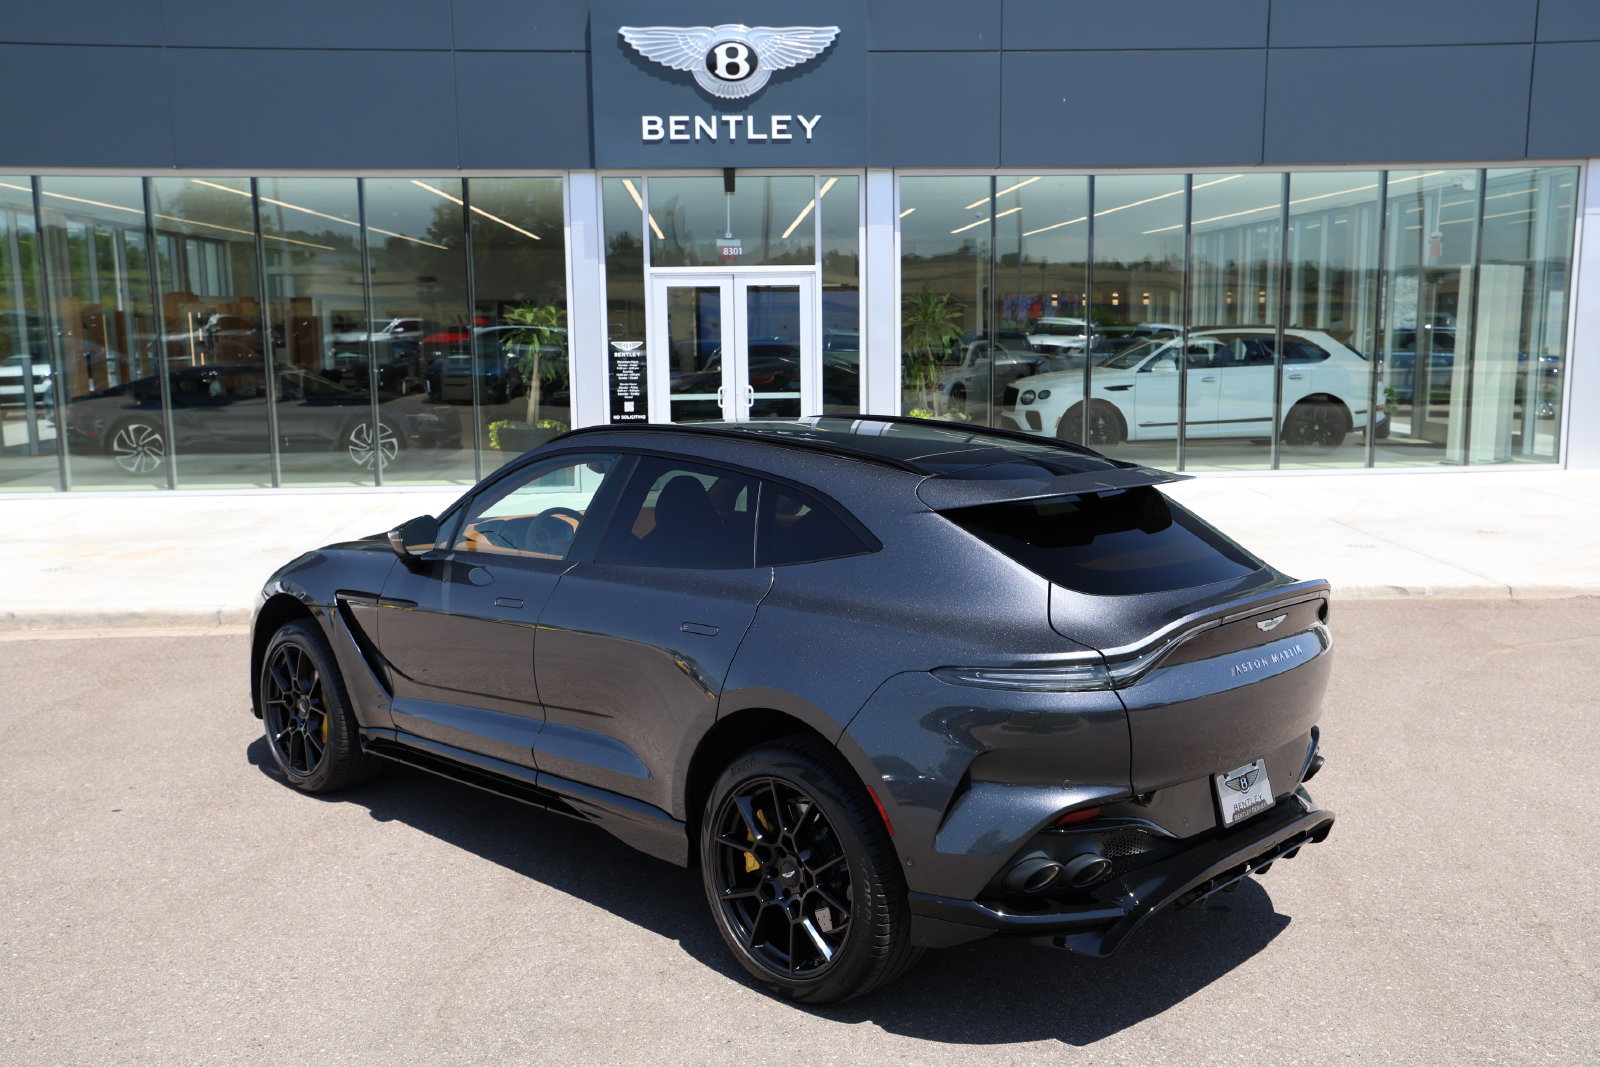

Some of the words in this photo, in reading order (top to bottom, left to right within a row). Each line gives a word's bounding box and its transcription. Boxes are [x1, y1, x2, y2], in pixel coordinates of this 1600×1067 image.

[713, 42, 750, 79] B
[641, 115, 822, 140] BENTLEY
[723, 247, 743, 256] 8301
[1234, 657, 1269, 676] ASTON
[1271, 644, 1303, 664] MARTIN
[1233, 793, 1263, 812] BENTLEY
[1234, 809, 1252, 821] BENTLEY
